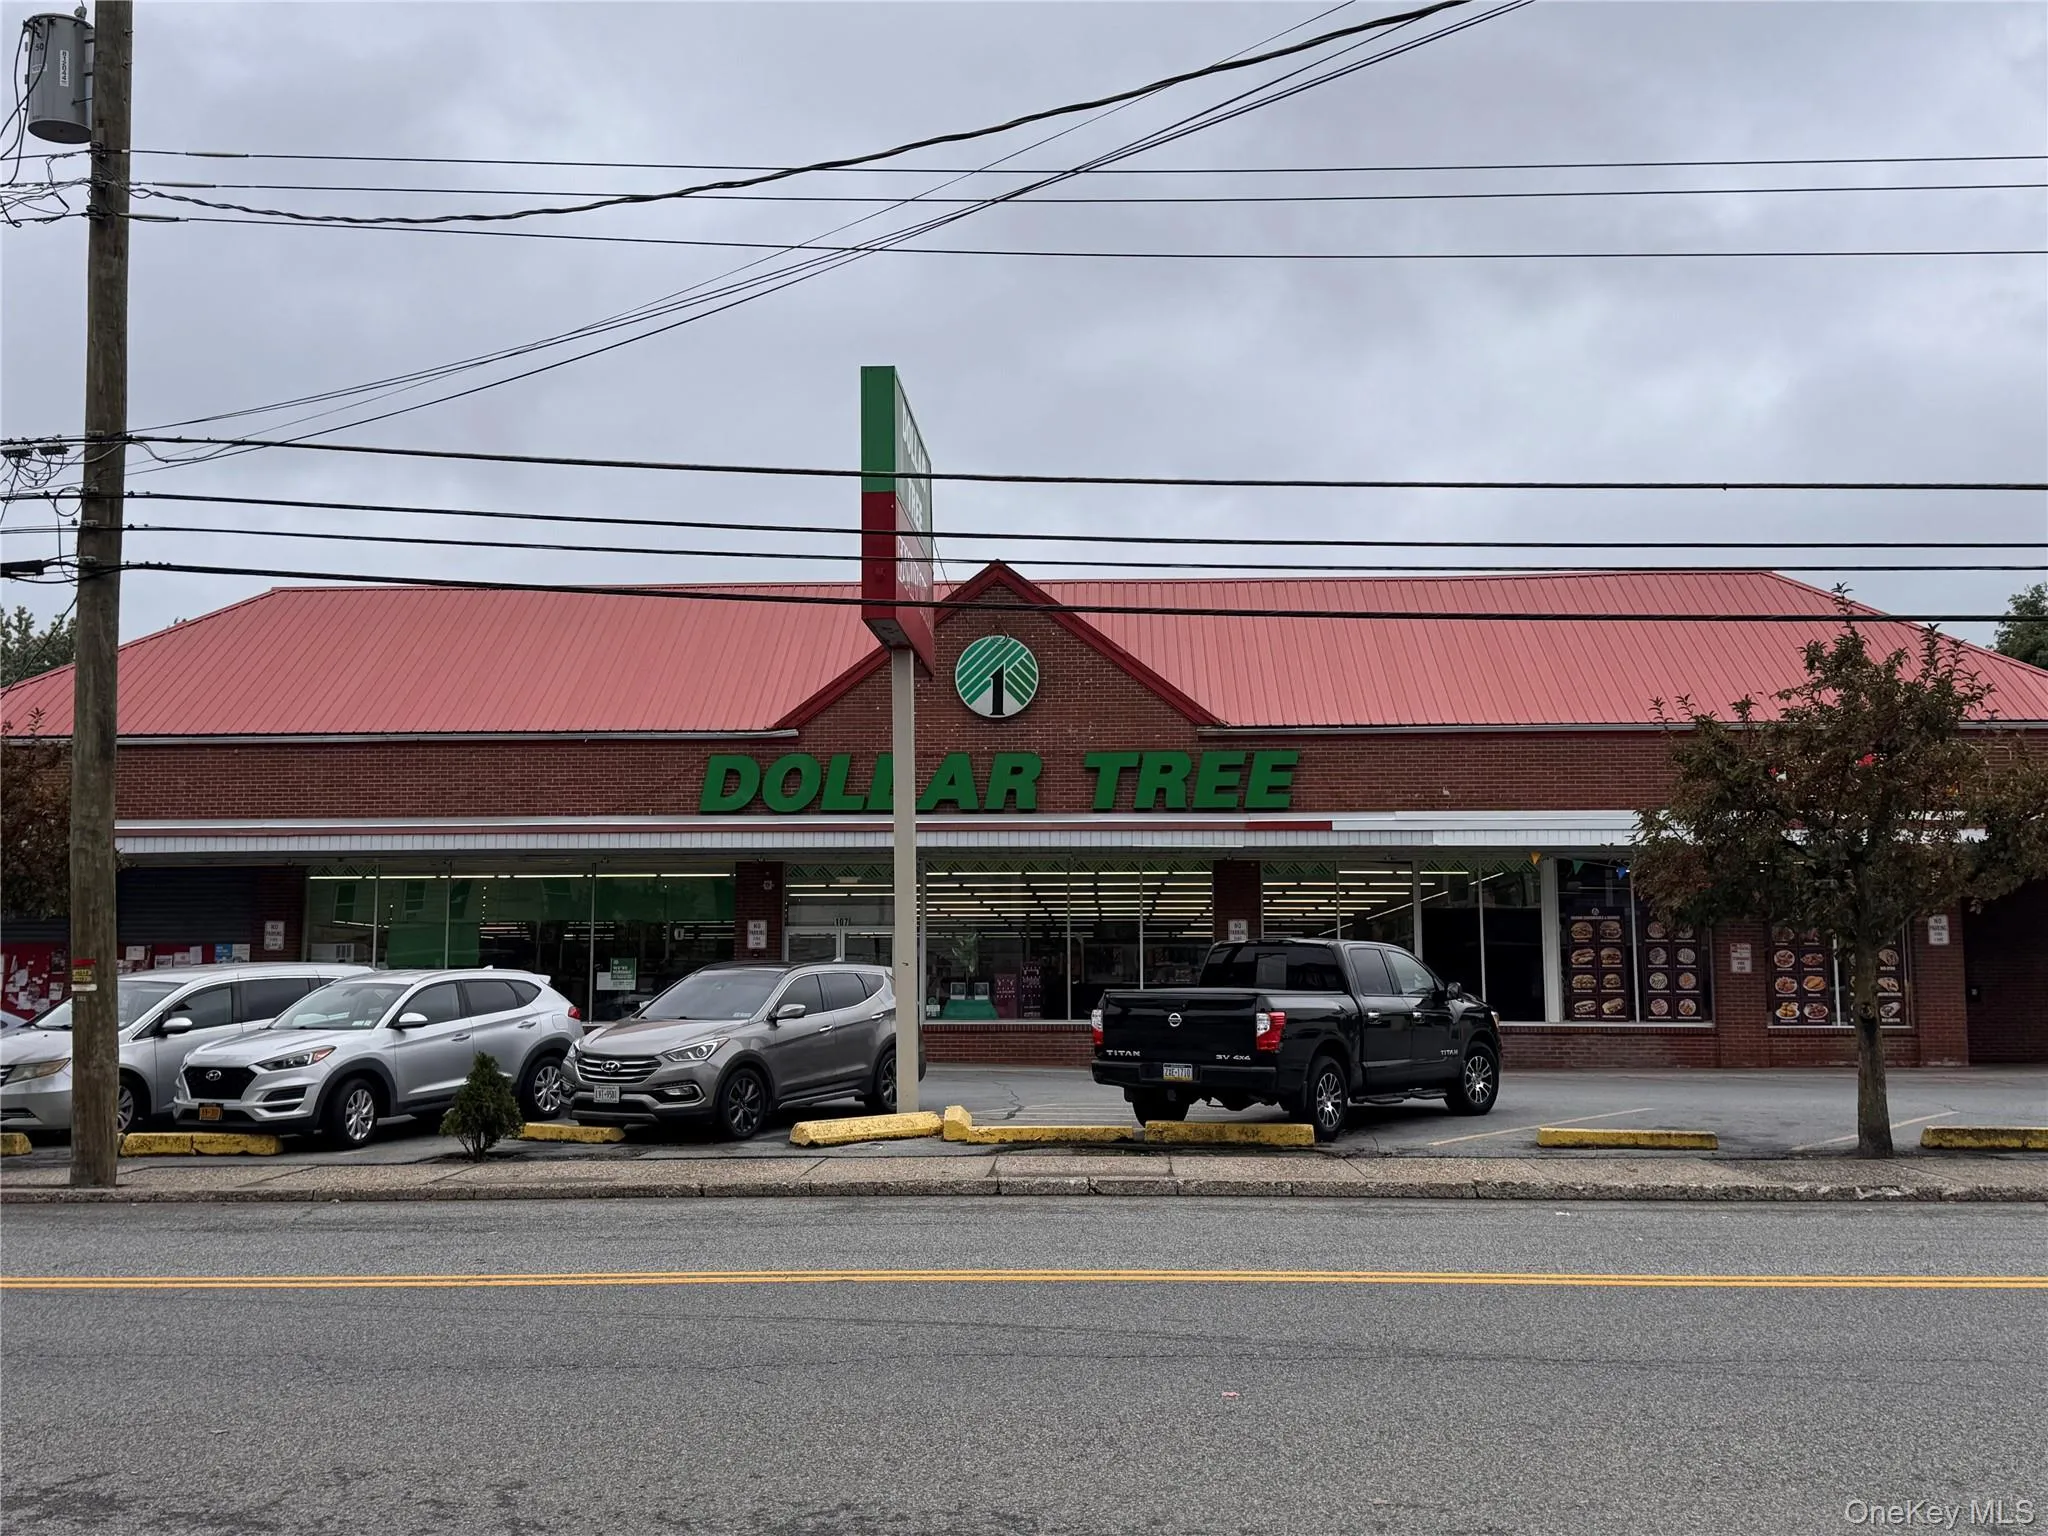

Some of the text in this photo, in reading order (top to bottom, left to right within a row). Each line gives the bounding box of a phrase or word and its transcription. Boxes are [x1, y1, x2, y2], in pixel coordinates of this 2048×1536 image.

[903, 400, 927, 492] DOLLAR
[699, 751, 1300, 812] DOLLAR TREE
